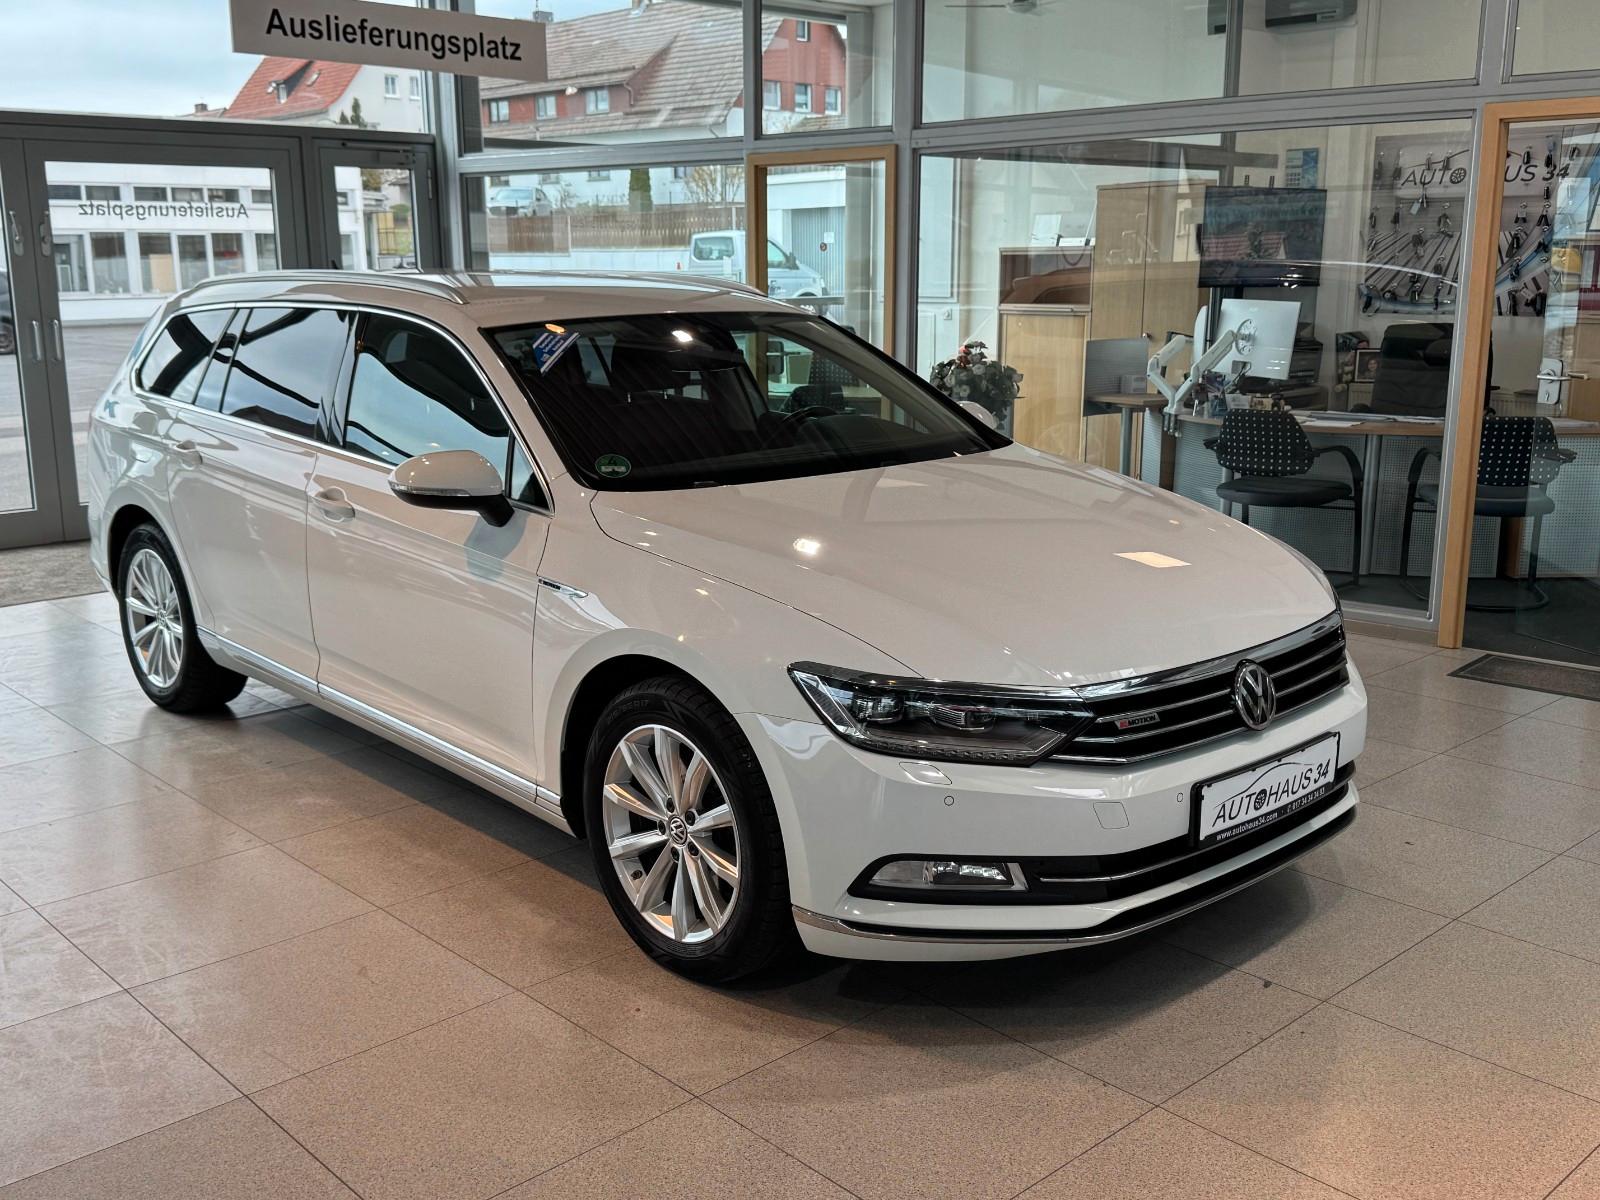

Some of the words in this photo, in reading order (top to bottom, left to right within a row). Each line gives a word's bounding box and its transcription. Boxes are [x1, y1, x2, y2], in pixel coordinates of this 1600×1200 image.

[266, 8, 522, 62] Auslieferungsplatz
[1314, 758, 1331, 784] 34
[1216, 812, 1278, 840] www.autohaus34.com
